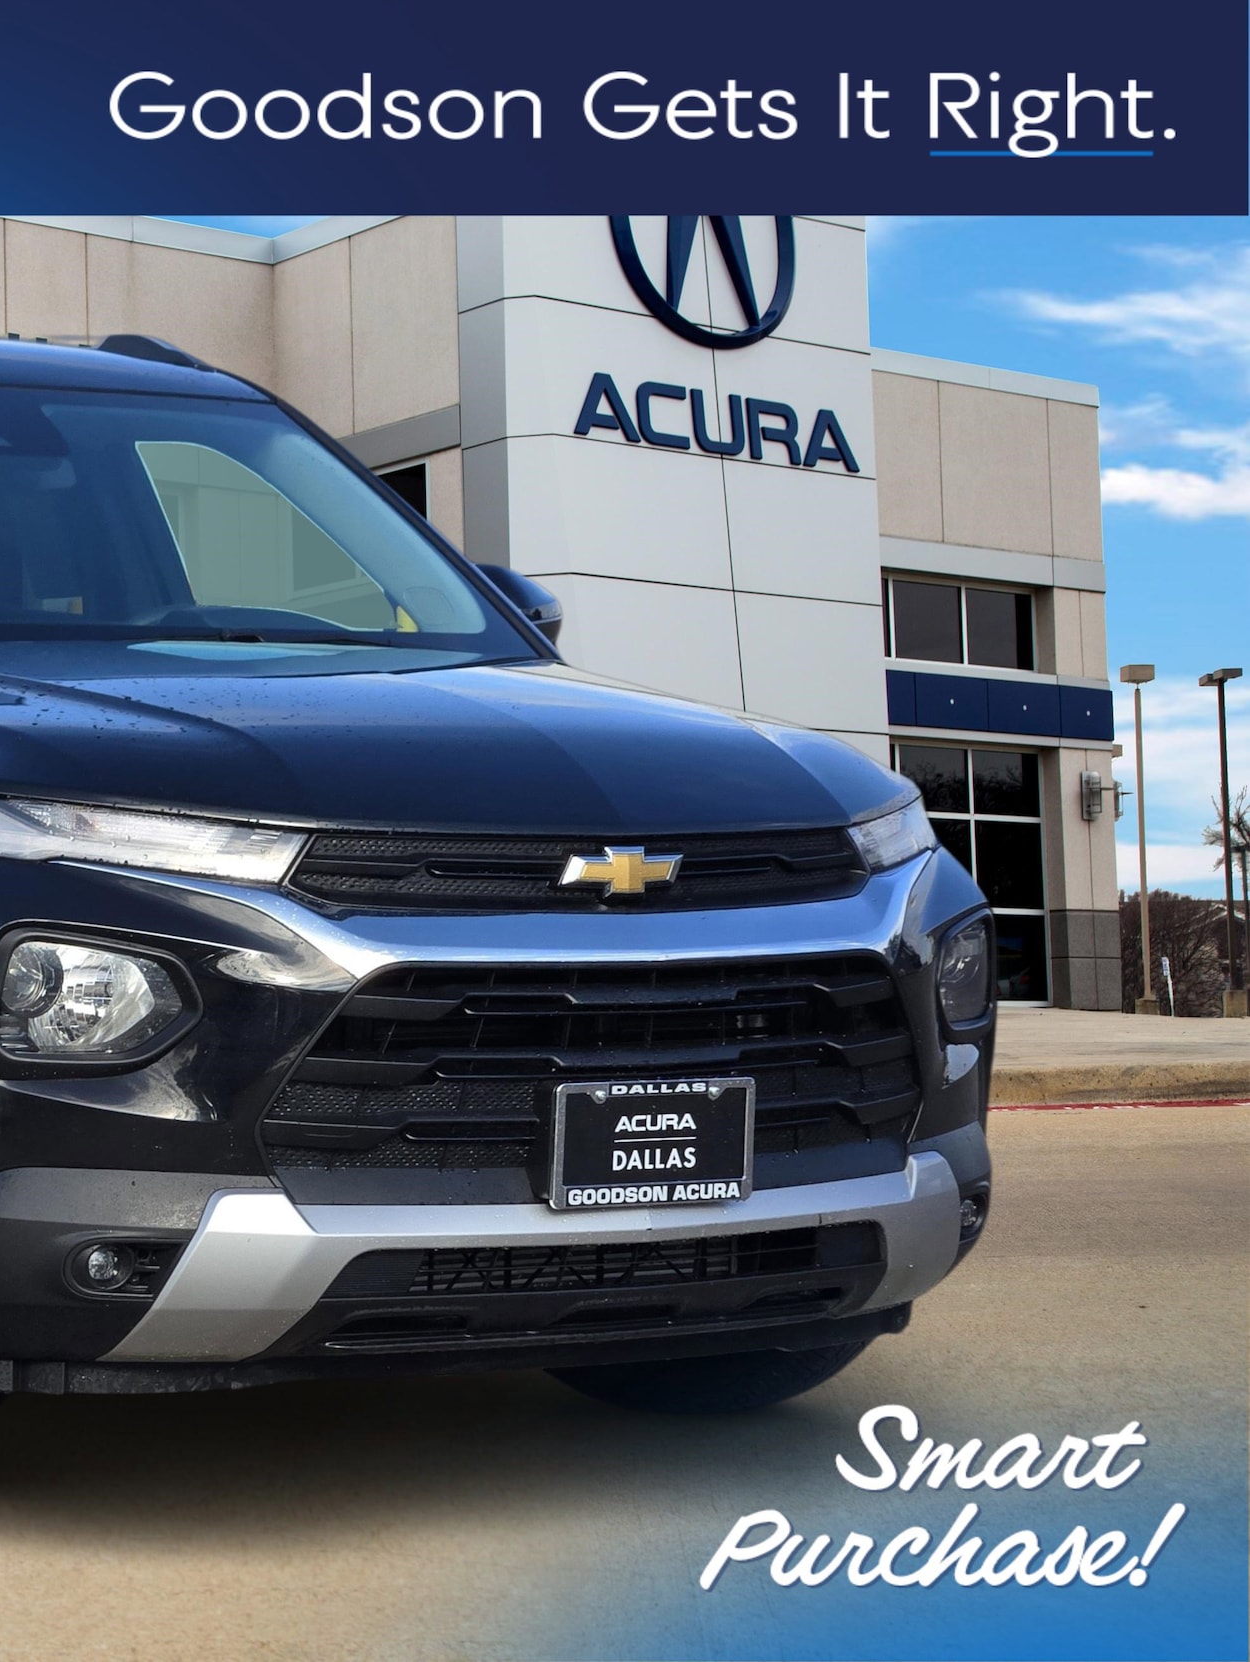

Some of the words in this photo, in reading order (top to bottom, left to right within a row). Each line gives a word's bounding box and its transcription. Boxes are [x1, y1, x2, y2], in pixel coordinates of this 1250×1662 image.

[574, 372, 860, 474] ACURA
[611, 1082, 707, 1095] DALLAS
[614, 1112, 697, 1133] ACURA
[612, 1146, 697, 1171] DALLAS
[567, 1185, 668, 1206] GOODSON
[673, 1182, 740, 1201] ACURA
